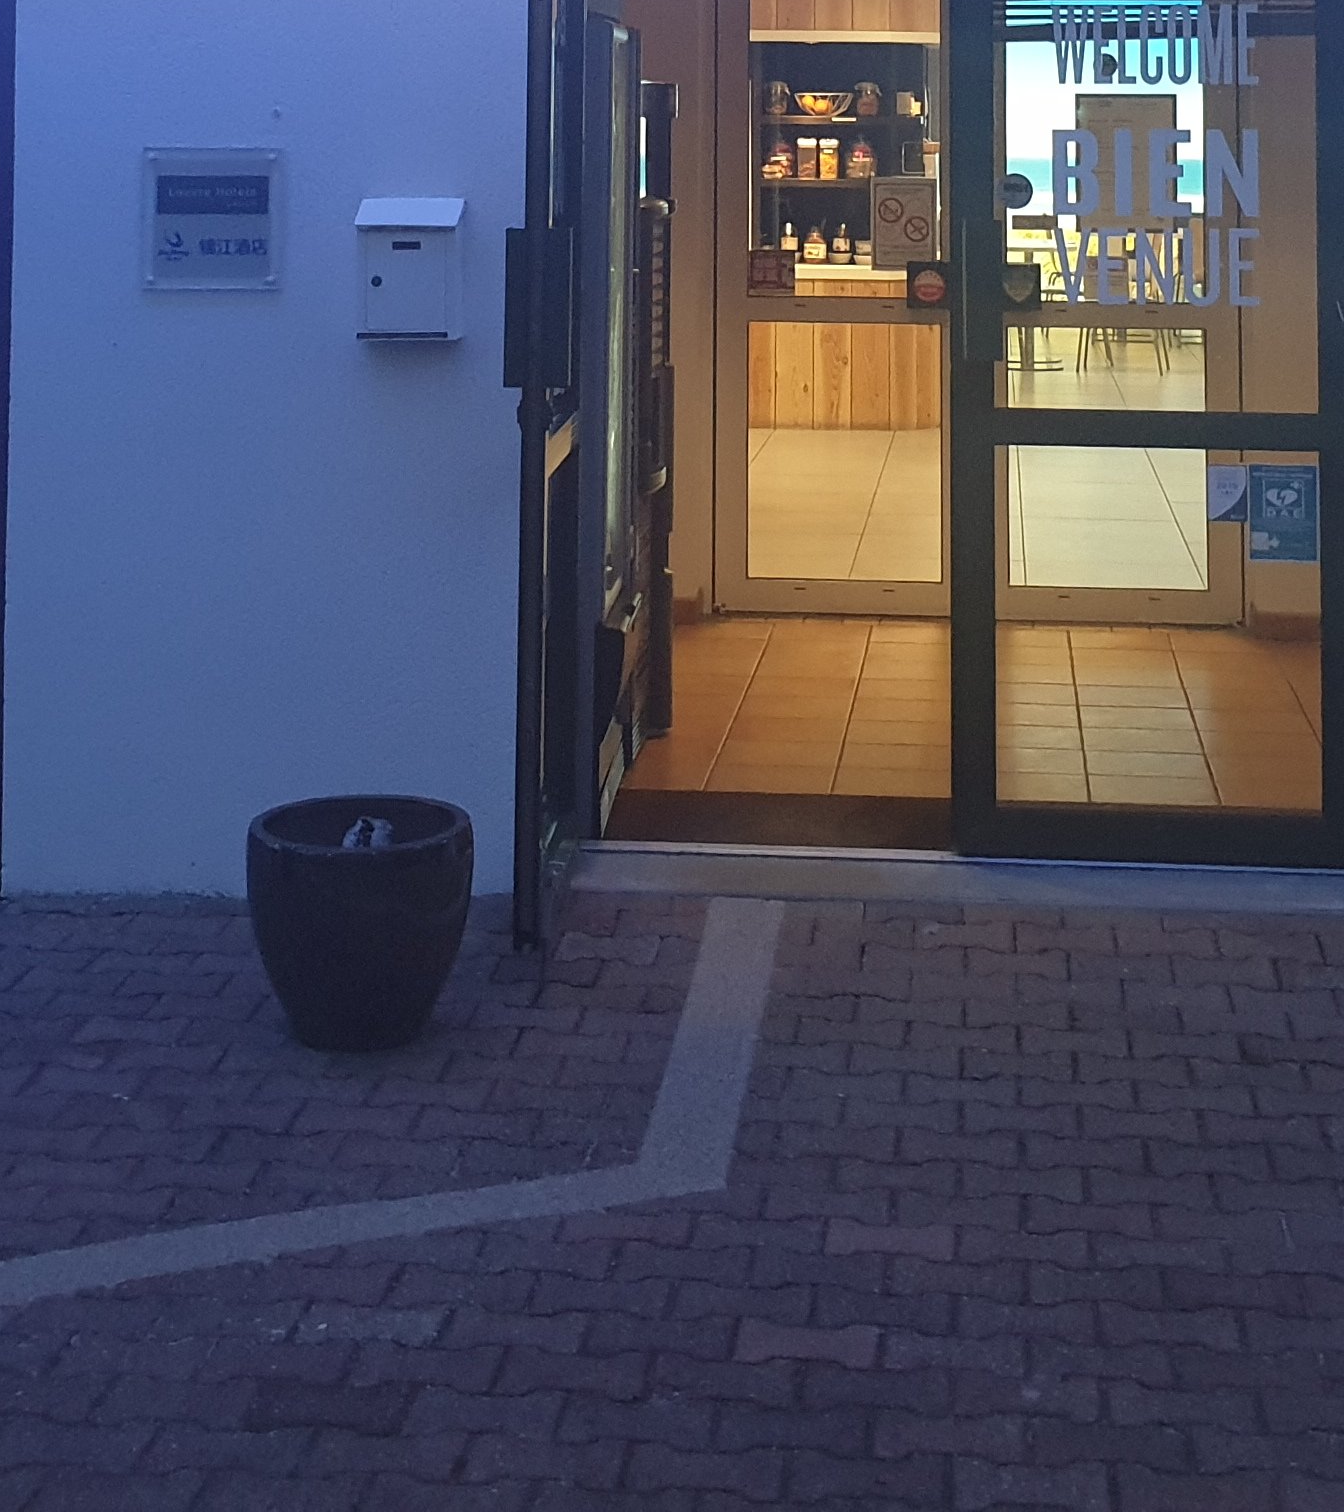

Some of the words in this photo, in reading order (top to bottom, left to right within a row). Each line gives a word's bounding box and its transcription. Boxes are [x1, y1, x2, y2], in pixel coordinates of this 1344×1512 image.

[1053, 3, 1259, 85] WELCOME
[1053, 129, 1260, 217] BIEN
[1055, 227, 1260, 307] VENUE
